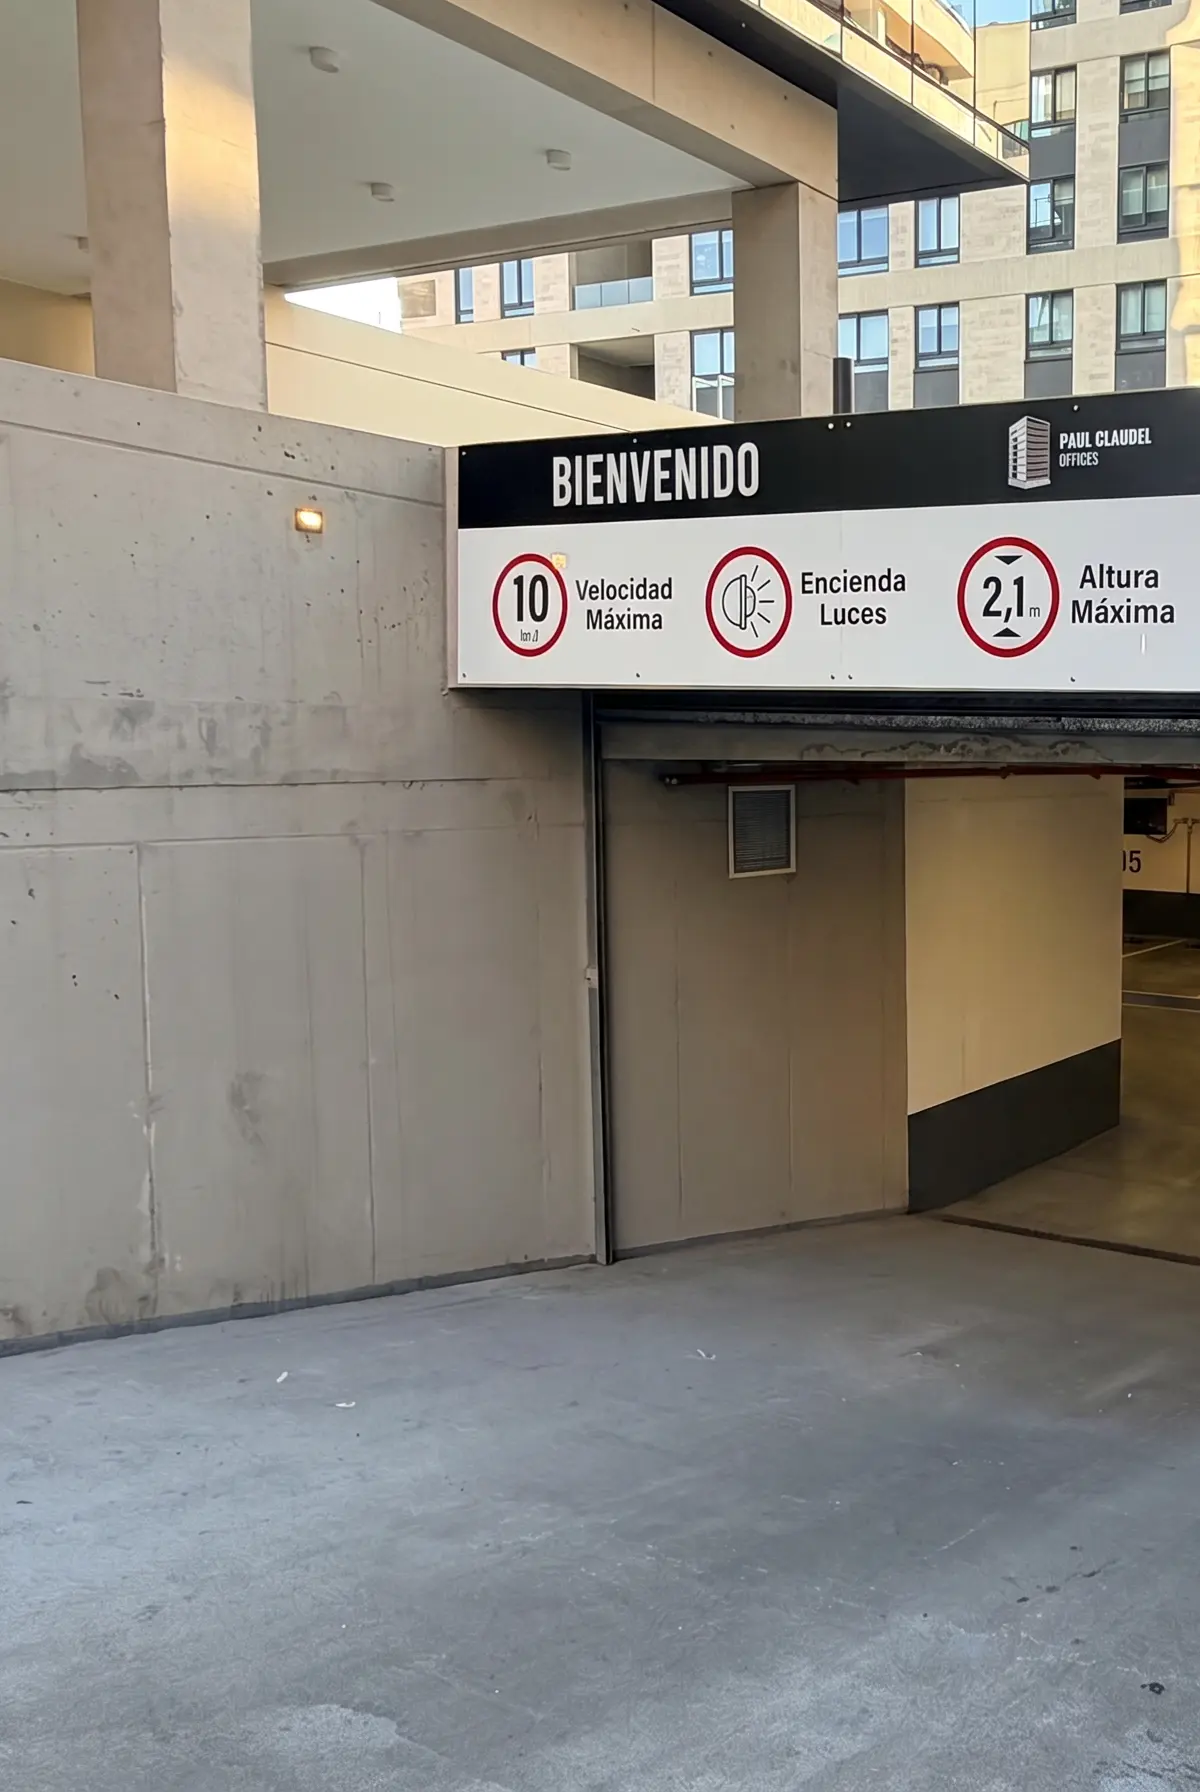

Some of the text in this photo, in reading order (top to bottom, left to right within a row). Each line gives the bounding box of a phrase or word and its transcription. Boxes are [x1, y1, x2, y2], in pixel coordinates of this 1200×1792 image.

[1059, 428, 1151, 449] PAUL CLAUDEL
[1060, 452, 1098, 467] OFFICES
[552, 441, 760, 507] BIENVENIDO
[802, 568, 905, 594] Encienda
[1080, 564, 1158, 588] Altura
[514, 575, 548, 622] 10
[576, 577, 672, 600] Velocidad
[983, 576, 1040, 623] 2,1 m
[587, 608, 662, 630] Máxima
[821, 604, 886, 625] Luces
[1072, 598, 1174, 623] Máxima
[1122, 849, 1142, 873] 5
